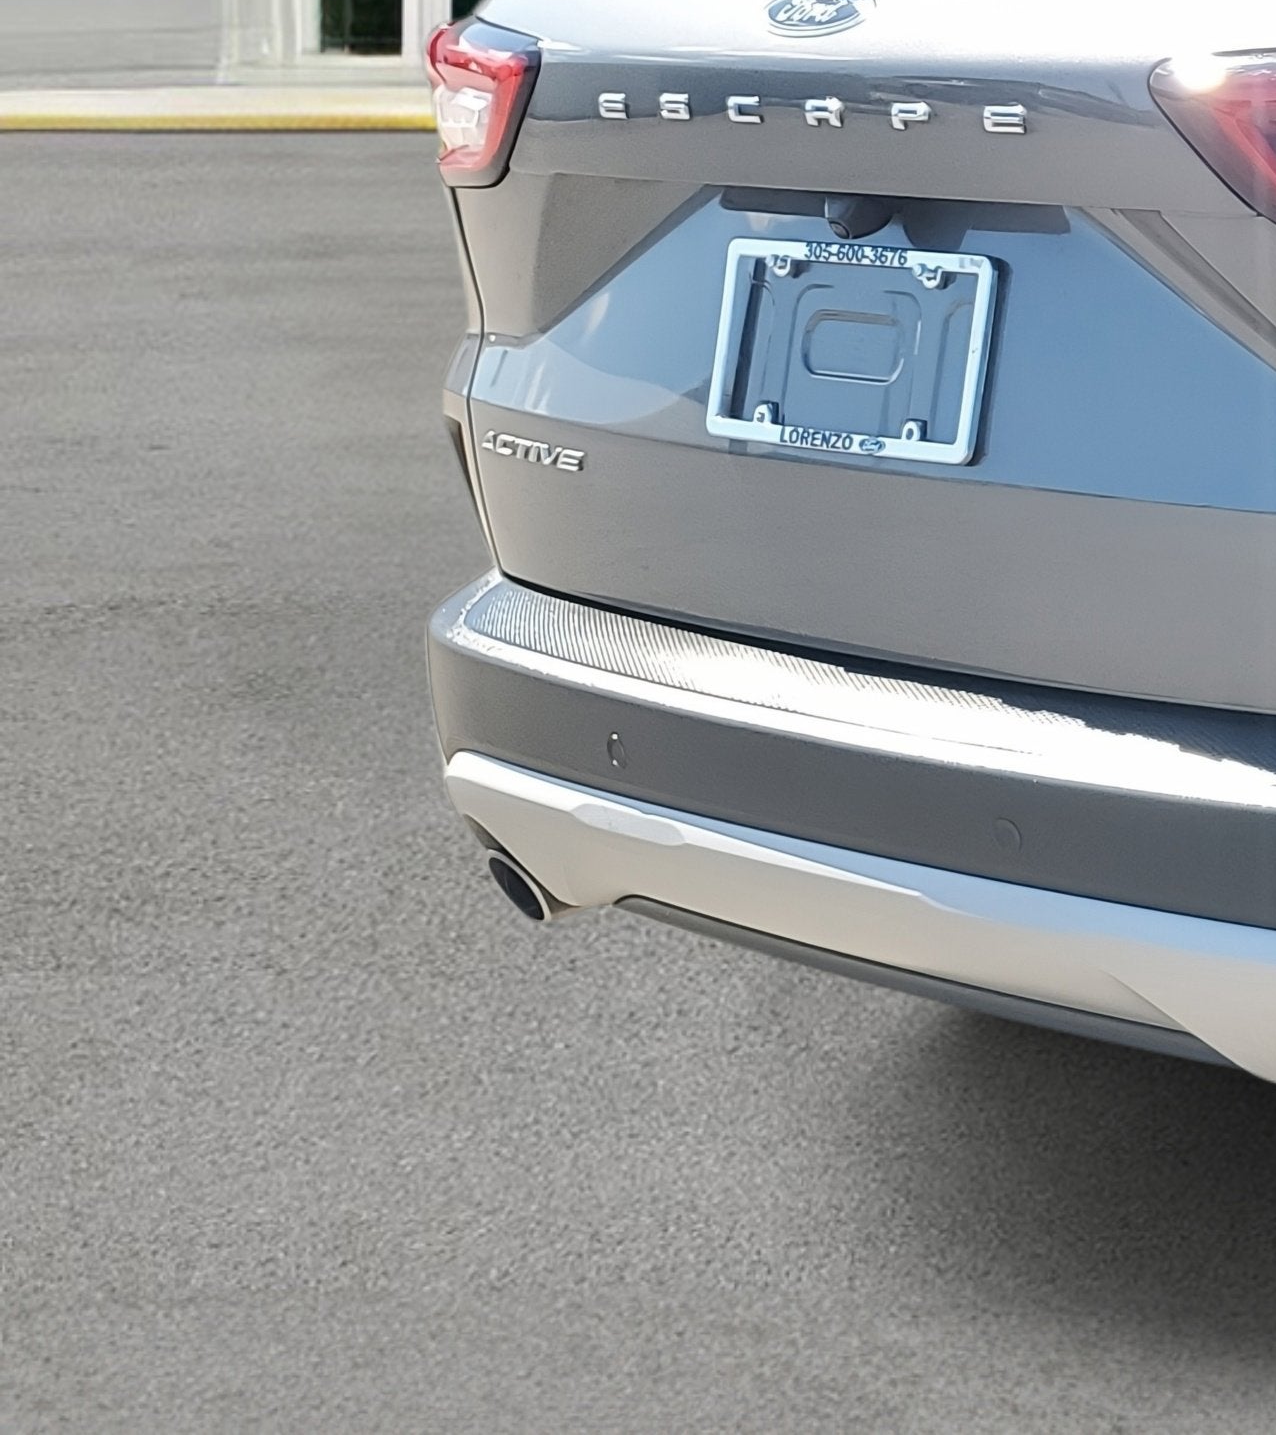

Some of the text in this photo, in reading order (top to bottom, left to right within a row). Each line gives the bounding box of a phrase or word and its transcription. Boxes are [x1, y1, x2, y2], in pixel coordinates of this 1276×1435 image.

[598, 92, 1027, 134] ESCAPE
[804, 241, 908, 266] 305-600-3676
[481, 429, 585, 472] ACTIVE
[779, 426, 854, 451] LORENZO
